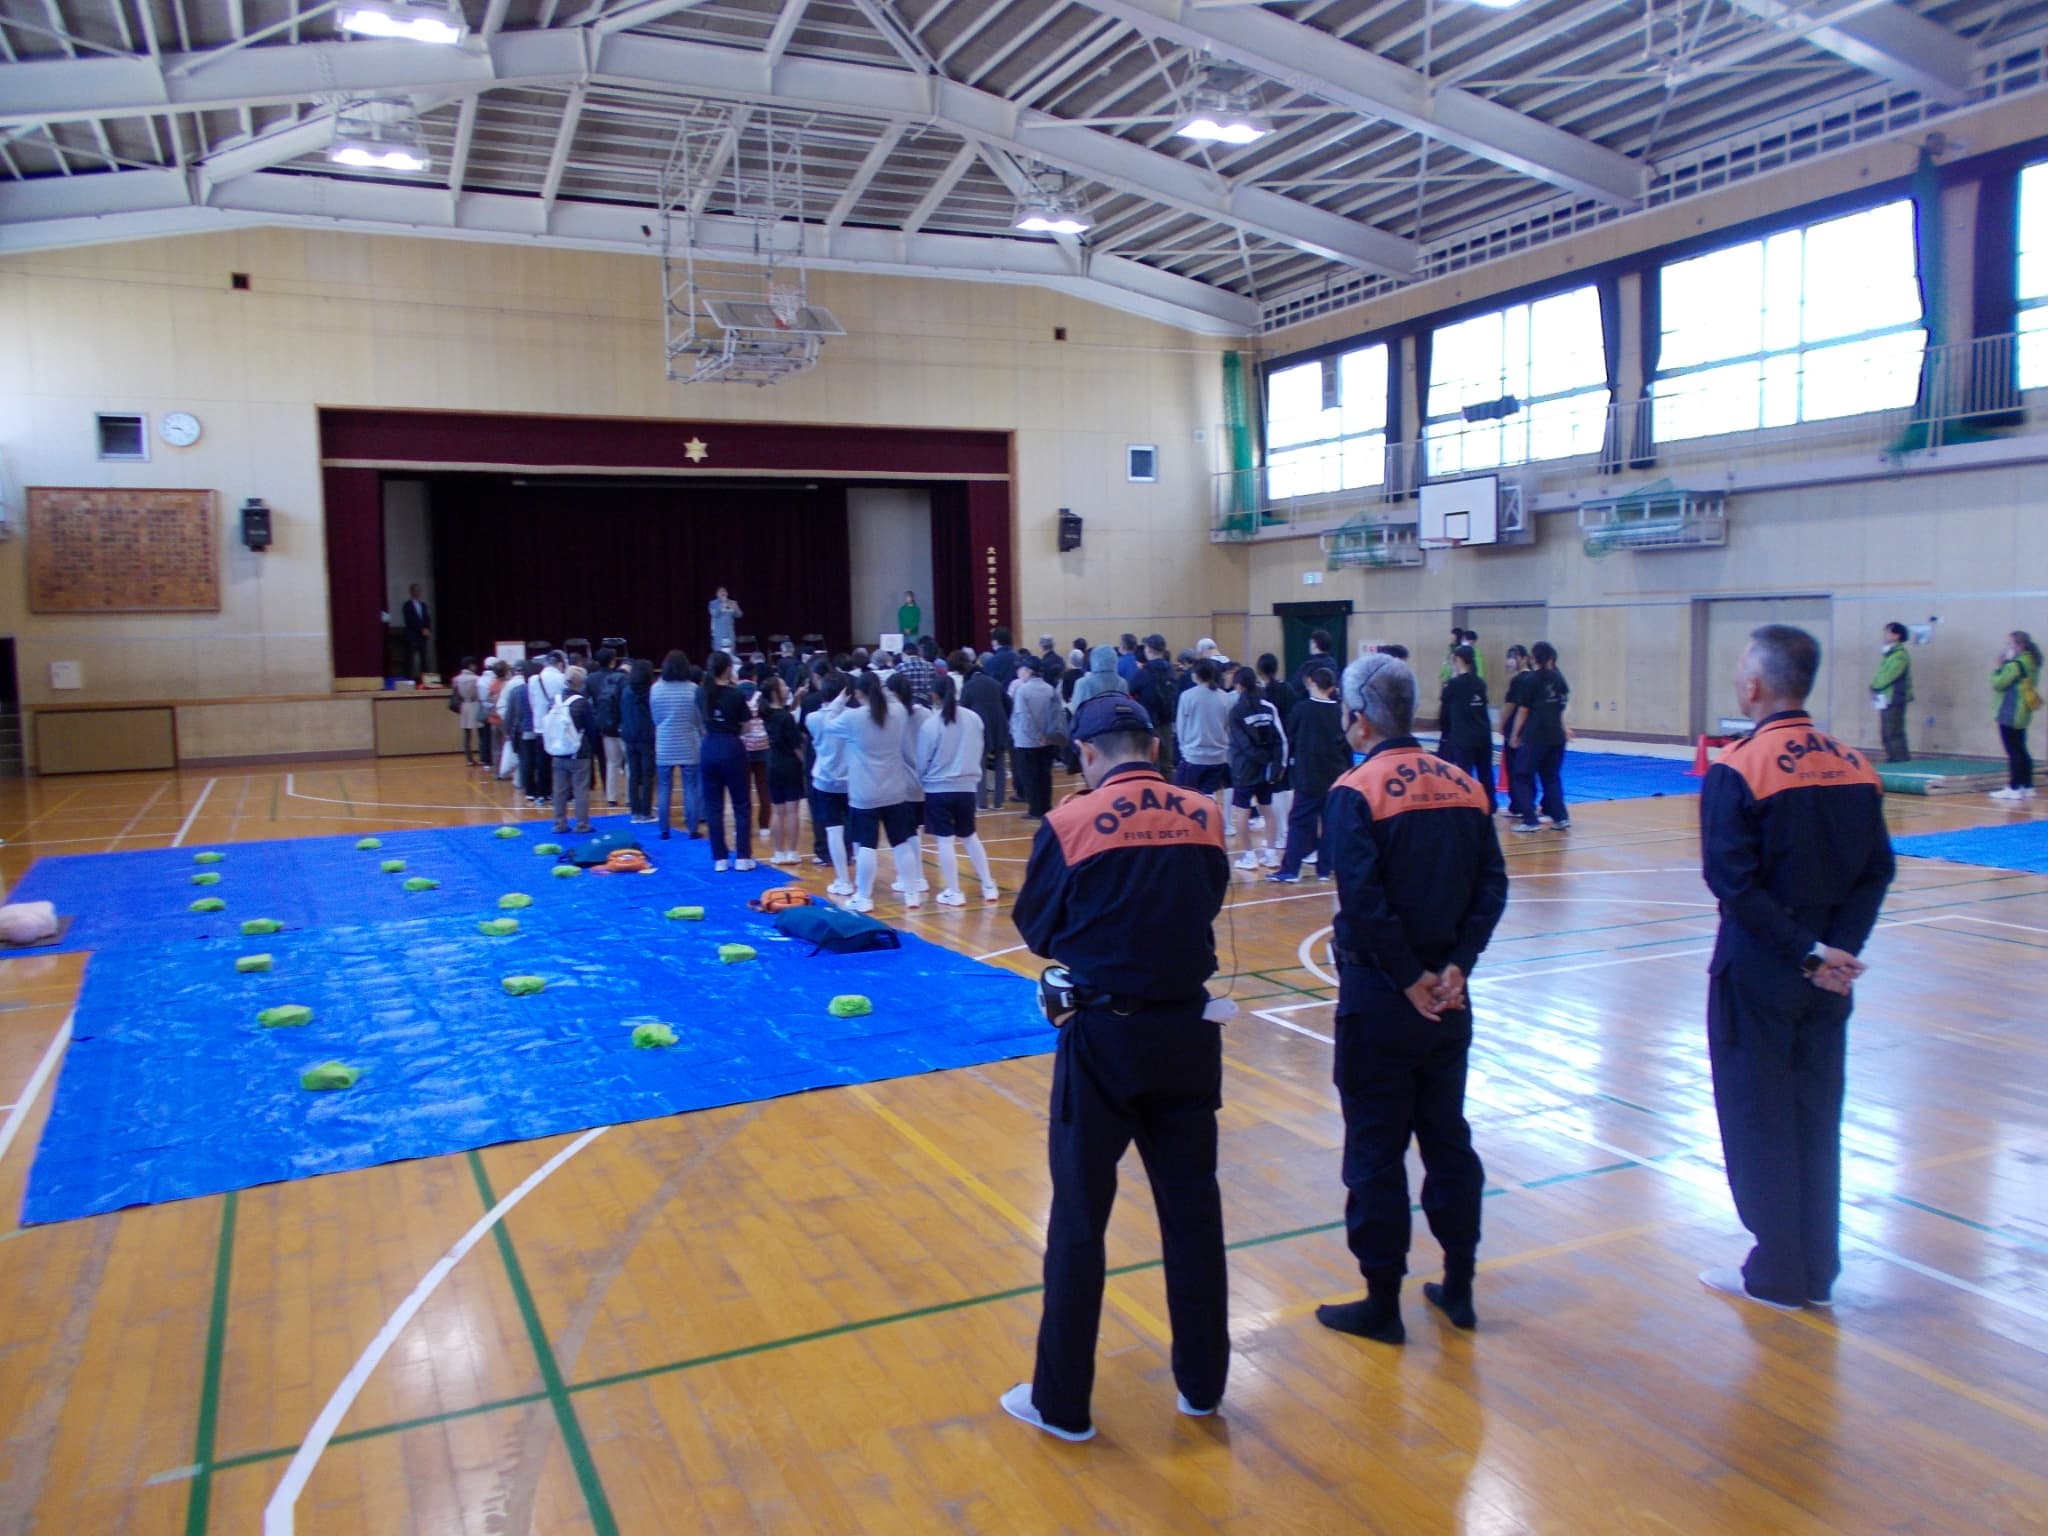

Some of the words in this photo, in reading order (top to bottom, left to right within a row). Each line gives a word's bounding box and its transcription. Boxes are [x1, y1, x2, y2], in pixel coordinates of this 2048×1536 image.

[1777, 733, 1861, 773] OSAKA
[1385, 757, 1472, 797] OSAKA
[1095, 788, 1208, 834] OSAKA
[1124, 830, 1153, 840] FIRE
